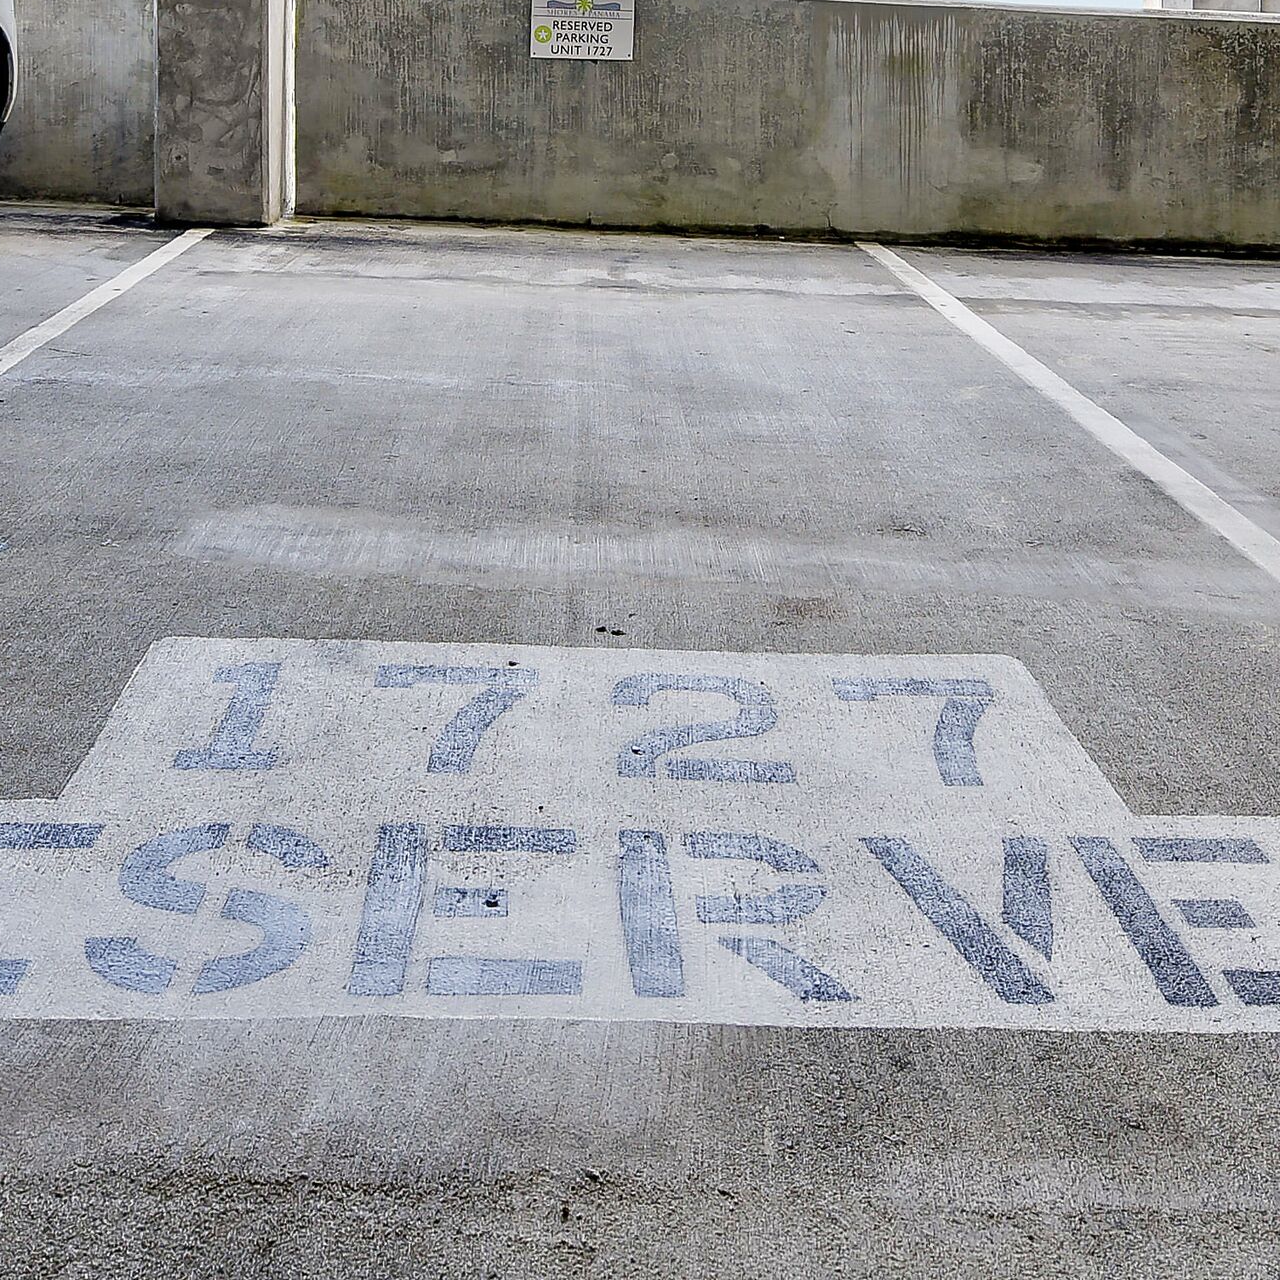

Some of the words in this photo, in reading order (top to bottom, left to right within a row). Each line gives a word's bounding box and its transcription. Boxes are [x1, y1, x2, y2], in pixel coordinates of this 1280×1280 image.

[552, 20, 613, 32] RESERVED
[556, 33, 609, 44] PARKING
[551, 45, 582, 55] UNIT
[587, 46, 613, 56] 1727
[173, 660, 994, 788] 1727
